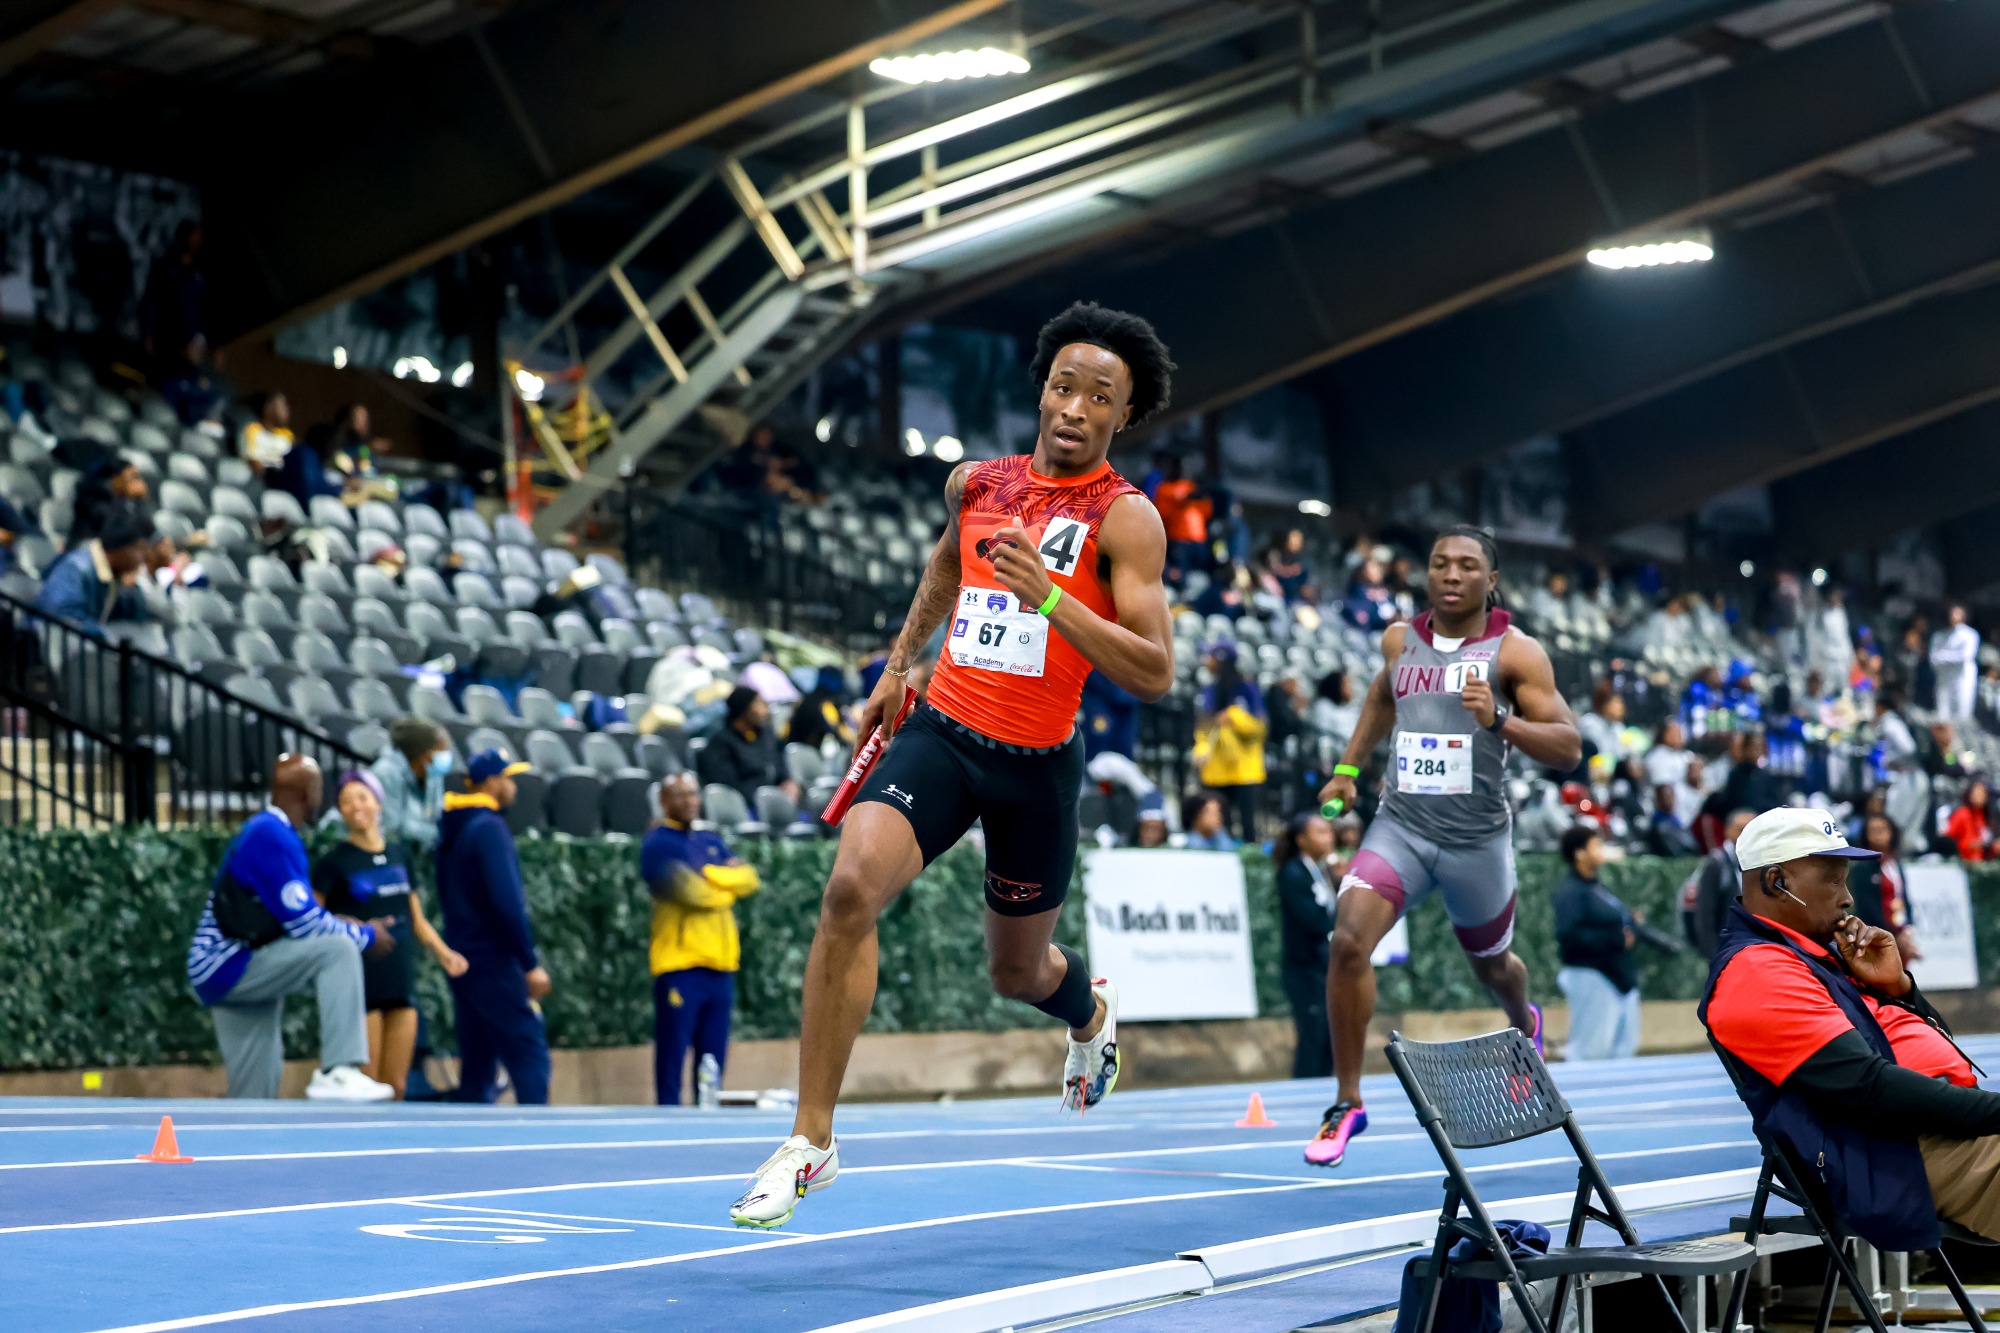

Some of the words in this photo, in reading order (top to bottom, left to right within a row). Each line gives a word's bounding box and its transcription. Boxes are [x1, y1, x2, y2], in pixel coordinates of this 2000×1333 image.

[1040, 524, 1080, 572] 4
[978, 622, 1008, 647] 67
[973, 656, 1005, 669] Academy
[1395, 664, 1452, 699] UNI
[847, 725, 883, 784] LAFLIN
[1413, 758, 1446, 776] 284
